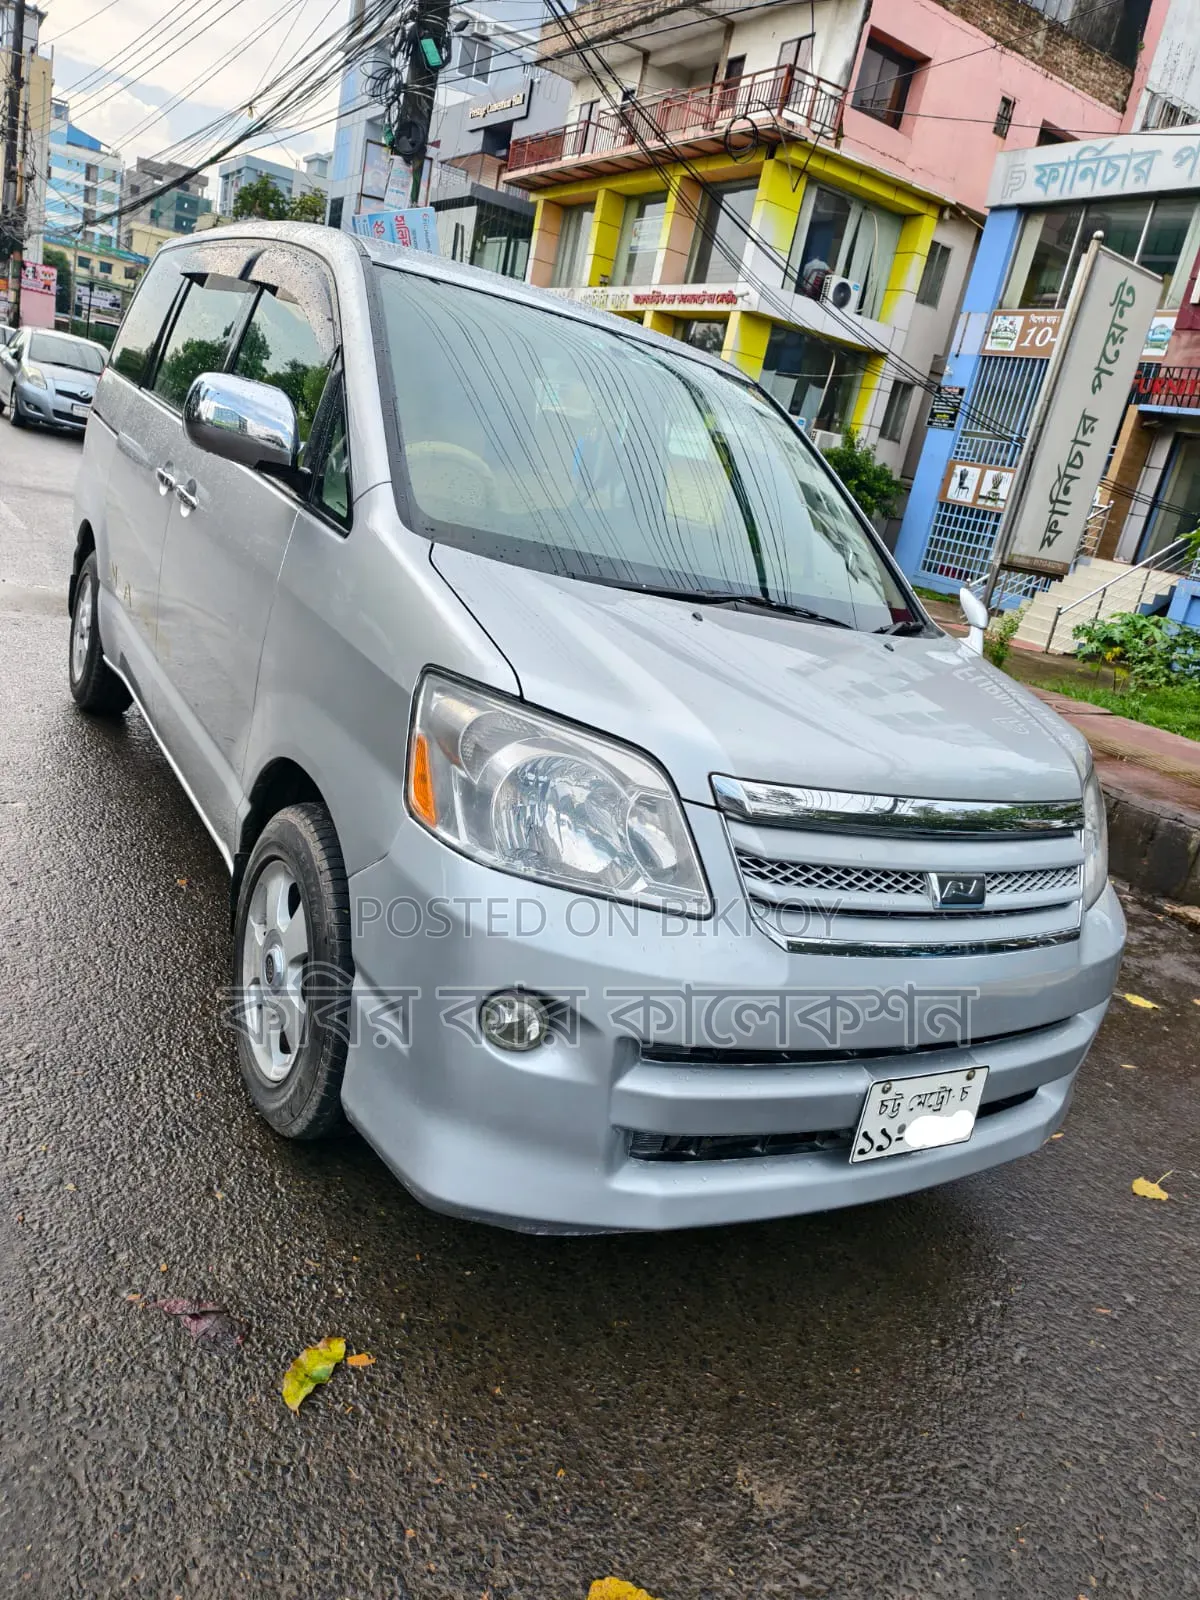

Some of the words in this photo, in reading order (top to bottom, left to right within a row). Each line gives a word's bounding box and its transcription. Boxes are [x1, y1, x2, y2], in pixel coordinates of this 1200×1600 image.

[1032, 141, 1162, 196] ফার্নিচার
[1091, 275, 1136, 396] পয়েন্ট
[1038, 408, 1099, 553] ফার্নিচার
